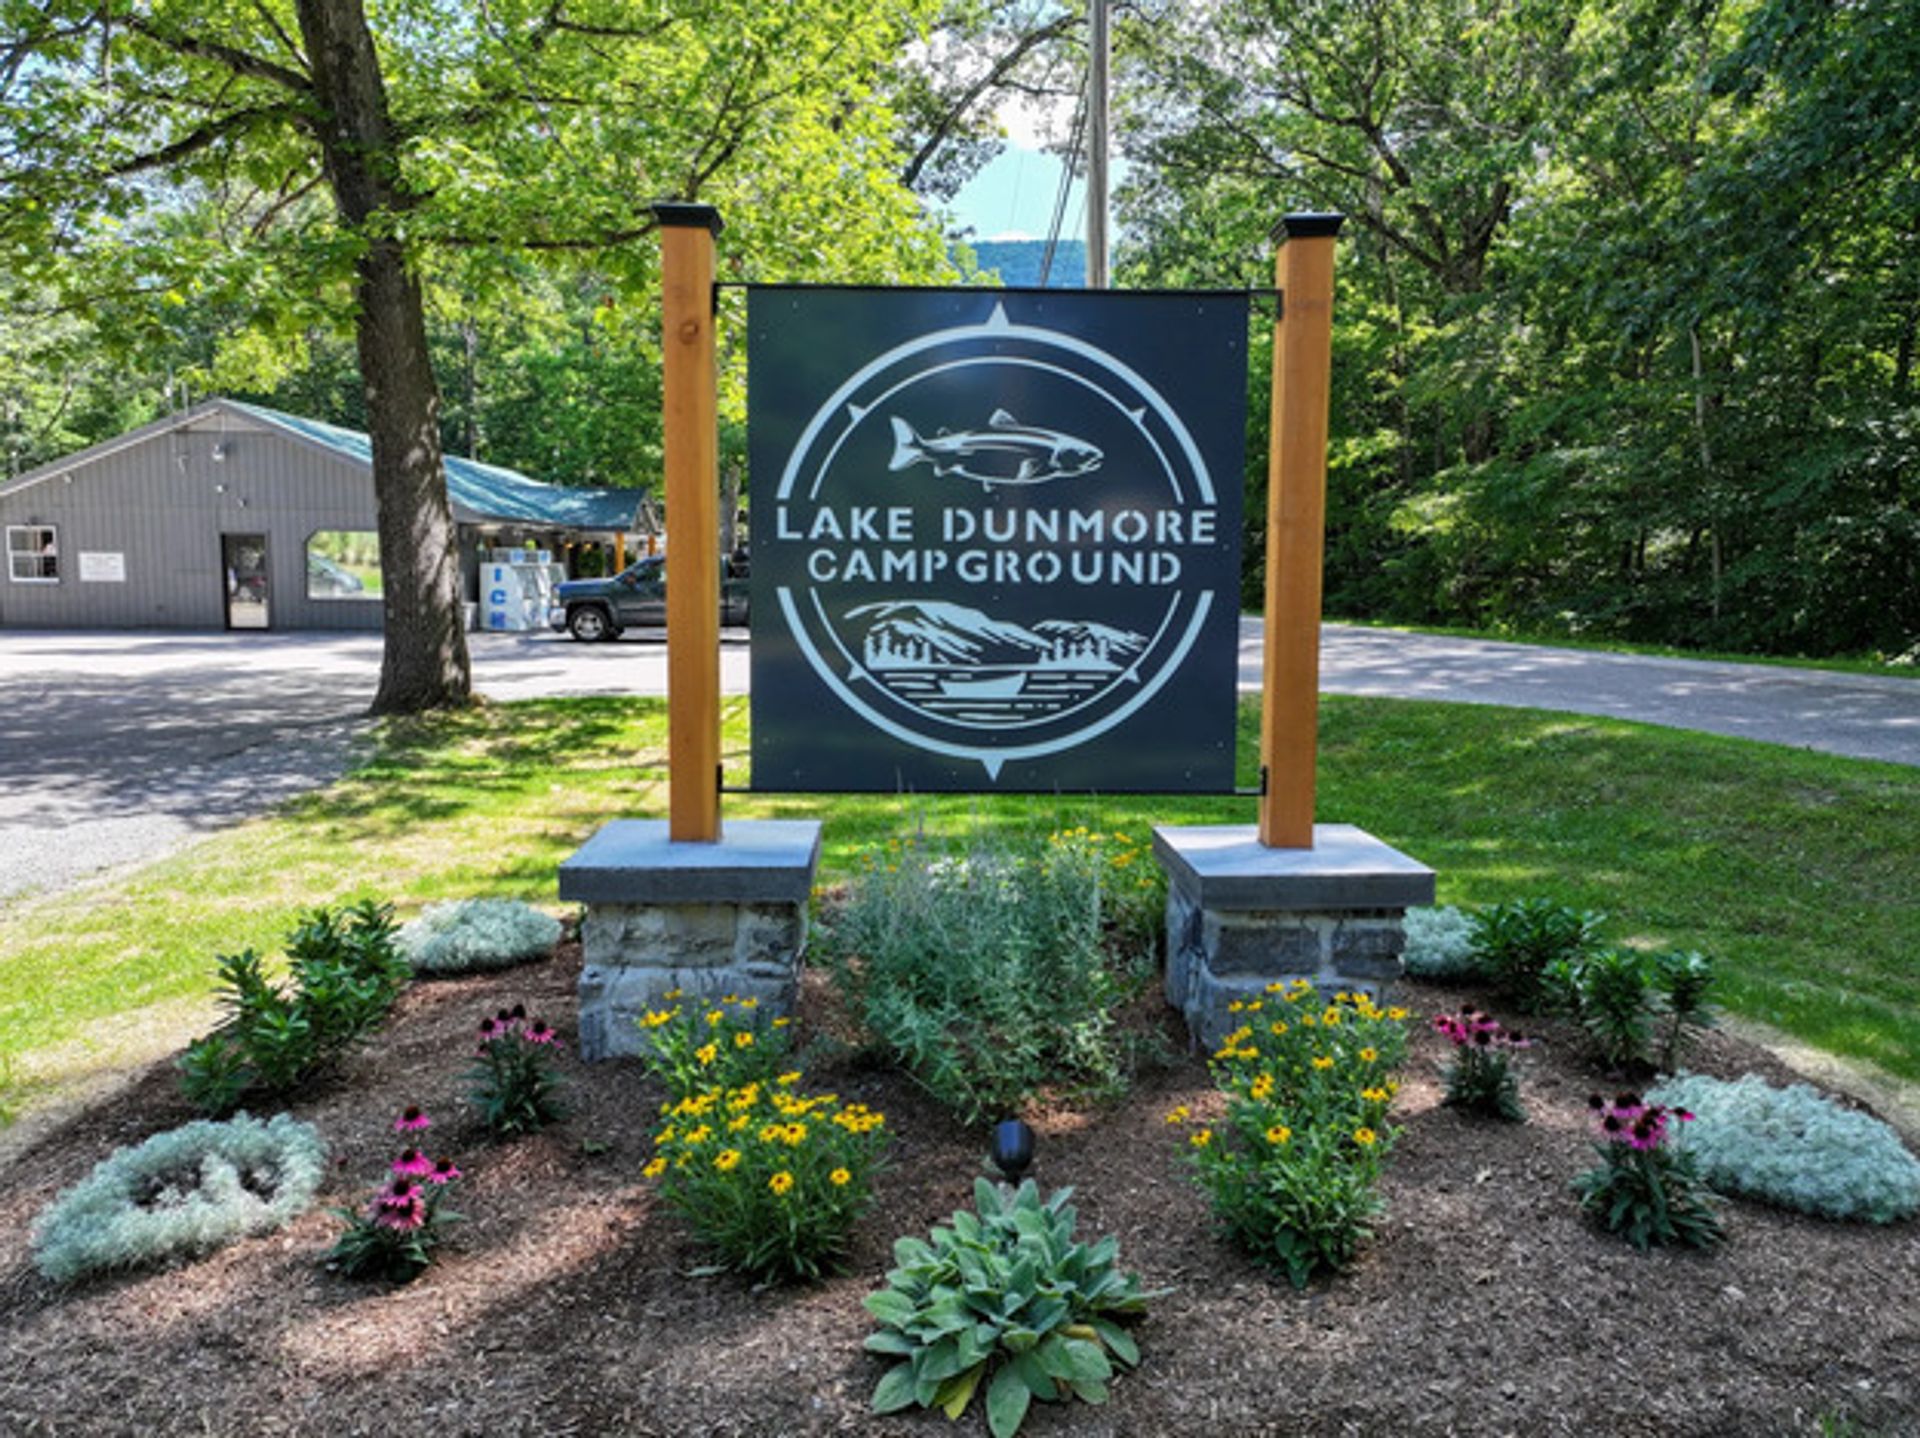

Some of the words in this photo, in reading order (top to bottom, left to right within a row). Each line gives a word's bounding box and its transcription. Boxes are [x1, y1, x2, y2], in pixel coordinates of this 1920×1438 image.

[776, 506, 915, 542] LAKE
[942, 508, 1217, 544] DUNMORE
[807, 549, 1182, 585] CAMPGROUND
